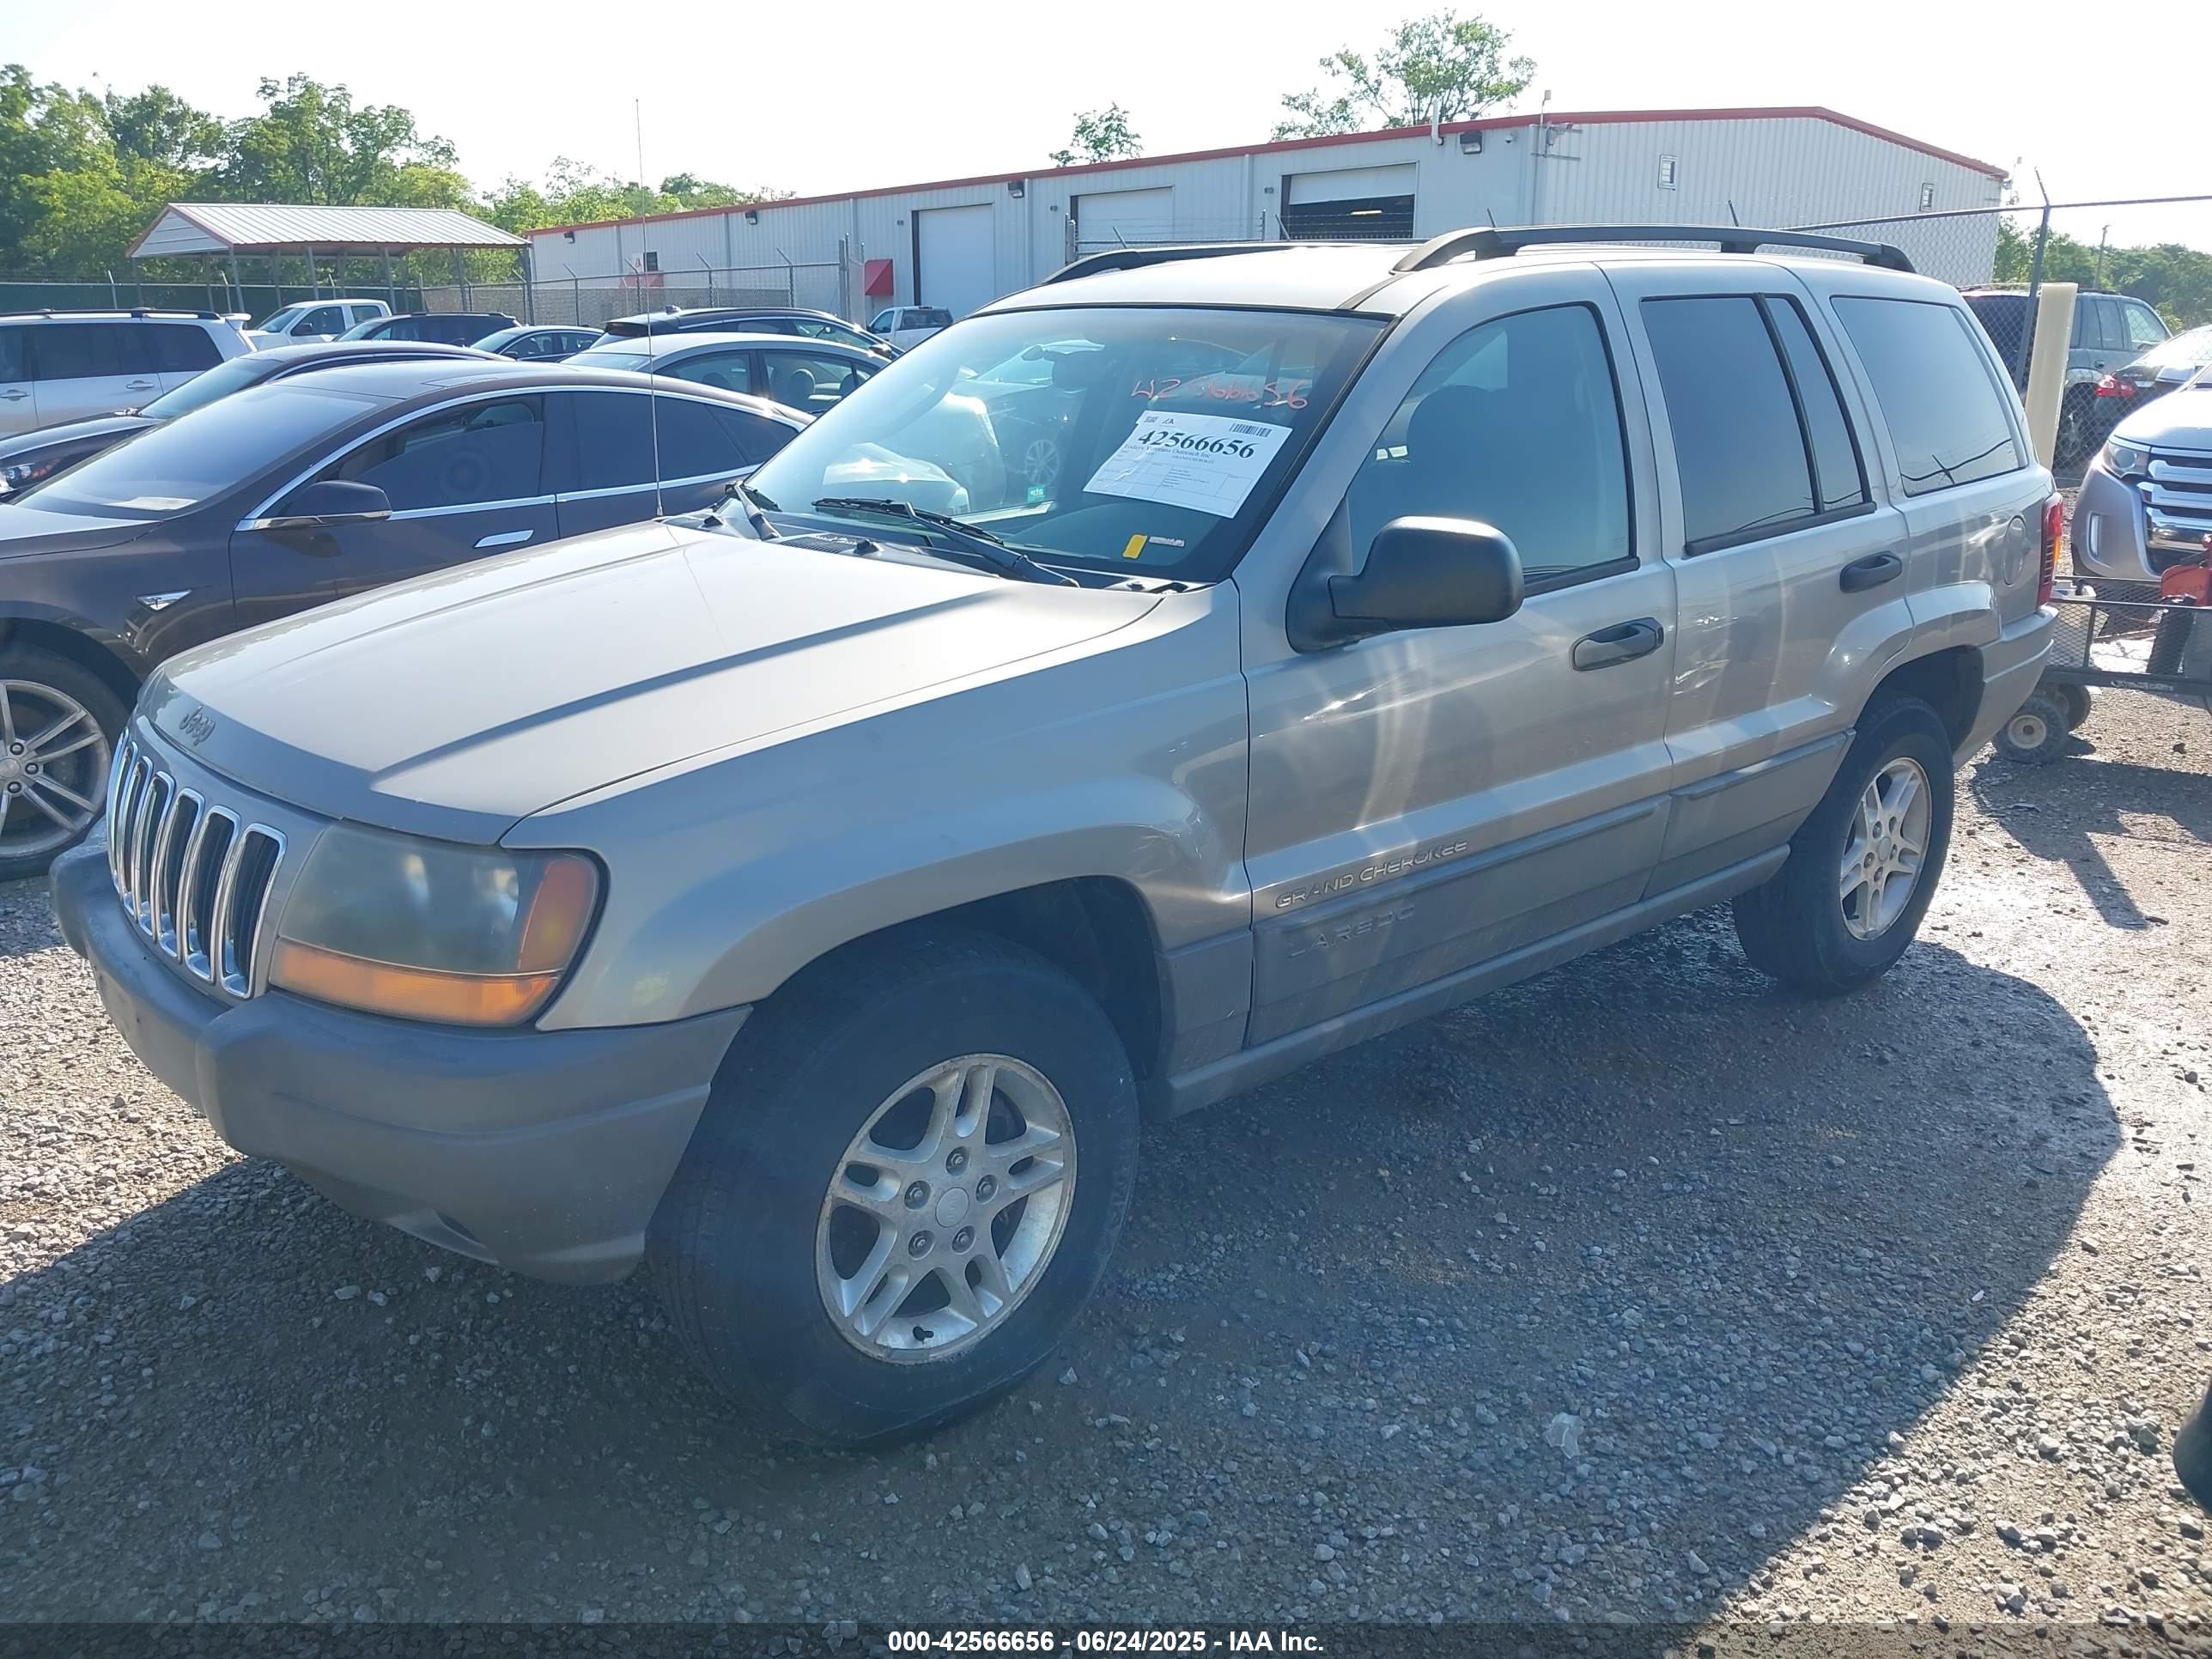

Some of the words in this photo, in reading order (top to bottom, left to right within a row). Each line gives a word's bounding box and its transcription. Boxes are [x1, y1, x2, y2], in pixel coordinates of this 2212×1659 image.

[1138, 429, 1260, 459] 42566656
[179, 704, 216, 746] Jeep
[1275, 874, 1354, 908] GRAND
[1358, 841, 1468, 883] CHEROKEE
